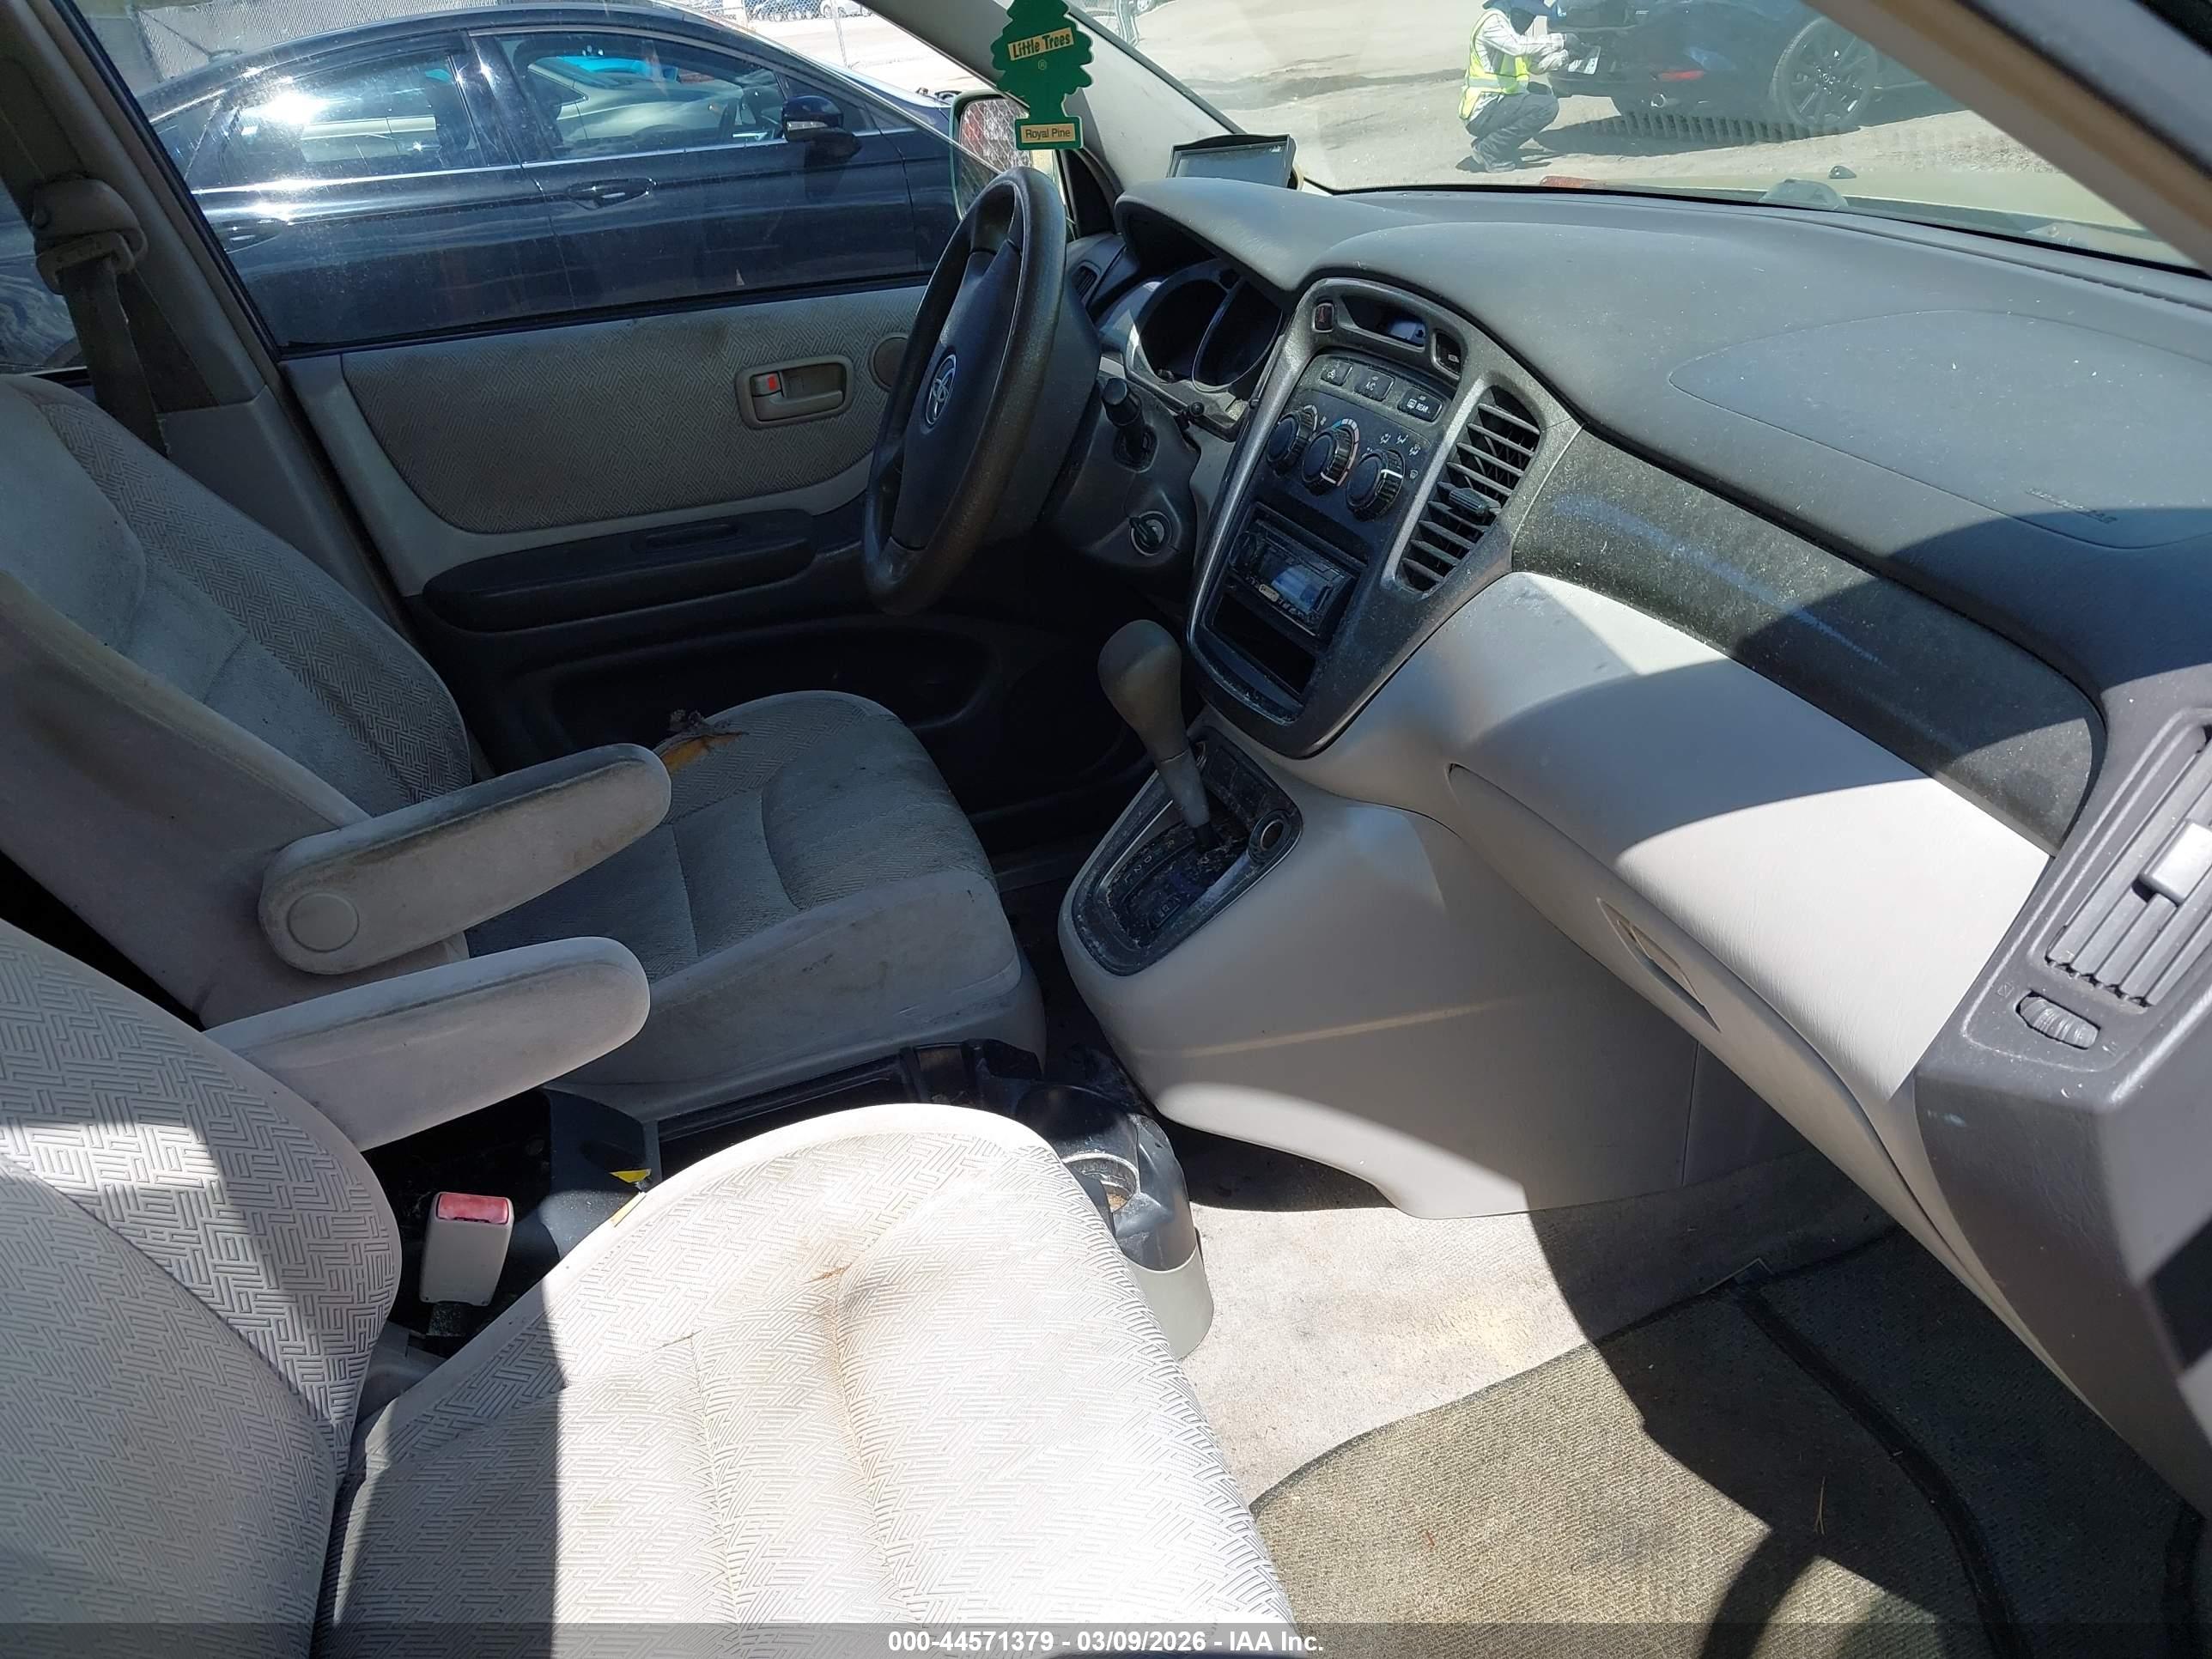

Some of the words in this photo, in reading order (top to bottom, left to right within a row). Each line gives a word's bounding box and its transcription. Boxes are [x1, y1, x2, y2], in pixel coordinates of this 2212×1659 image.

[1012, 40, 1041, 58] Little
[1042, 33, 1072, 50] Trees
[1025, 128, 1049, 140] Royal
[1051, 127, 1071, 137] Pine
[1366, 381, 1376, 391] A/C
[1416, 403, 1429, 412] REAR
